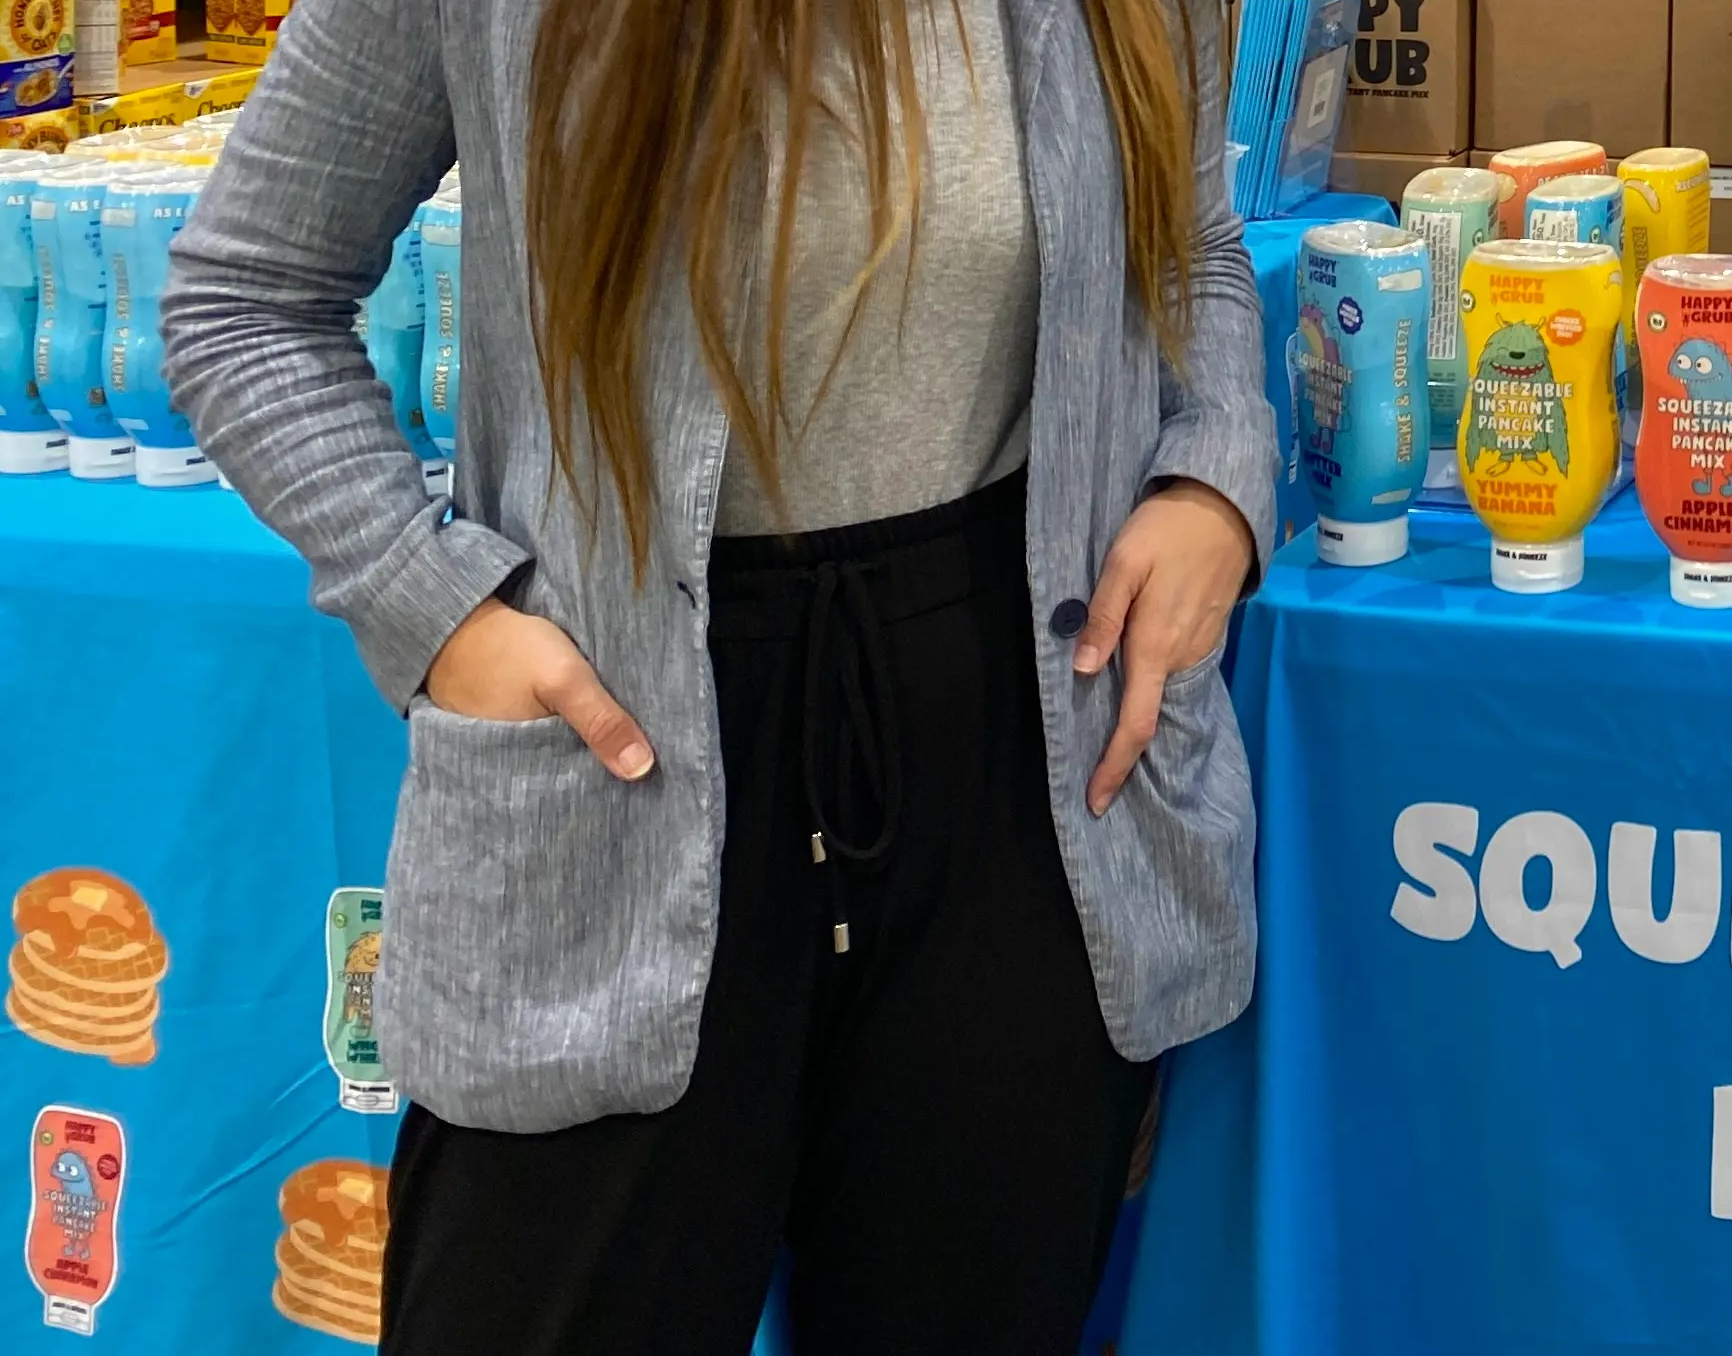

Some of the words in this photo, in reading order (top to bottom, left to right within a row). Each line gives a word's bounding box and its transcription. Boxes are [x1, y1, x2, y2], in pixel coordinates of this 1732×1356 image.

[1309, 254, 1337, 273] HAPPY
[1313, 269, 1337, 288] GRUB
[1490, 275, 1544, 292] HAPPY
[1501, 290, 1544, 305] GRUB
[1394, 318, 1413, 388] SQUEEZE
[1469, 378, 1572, 398] SQUEEZABLE
[1479, 397, 1554, 415] INSTANT
[1478, 416, 1554, 433] PANCAKE
[1396, 408, 1413, 464] SHAKE
[1497, 435, 1532, 449] MIX
[1690, 454, 1725, 468] MIX
[1477, 479, 1557, 500] YUMMY
[1478, 499, 1556, 516] BANANA
